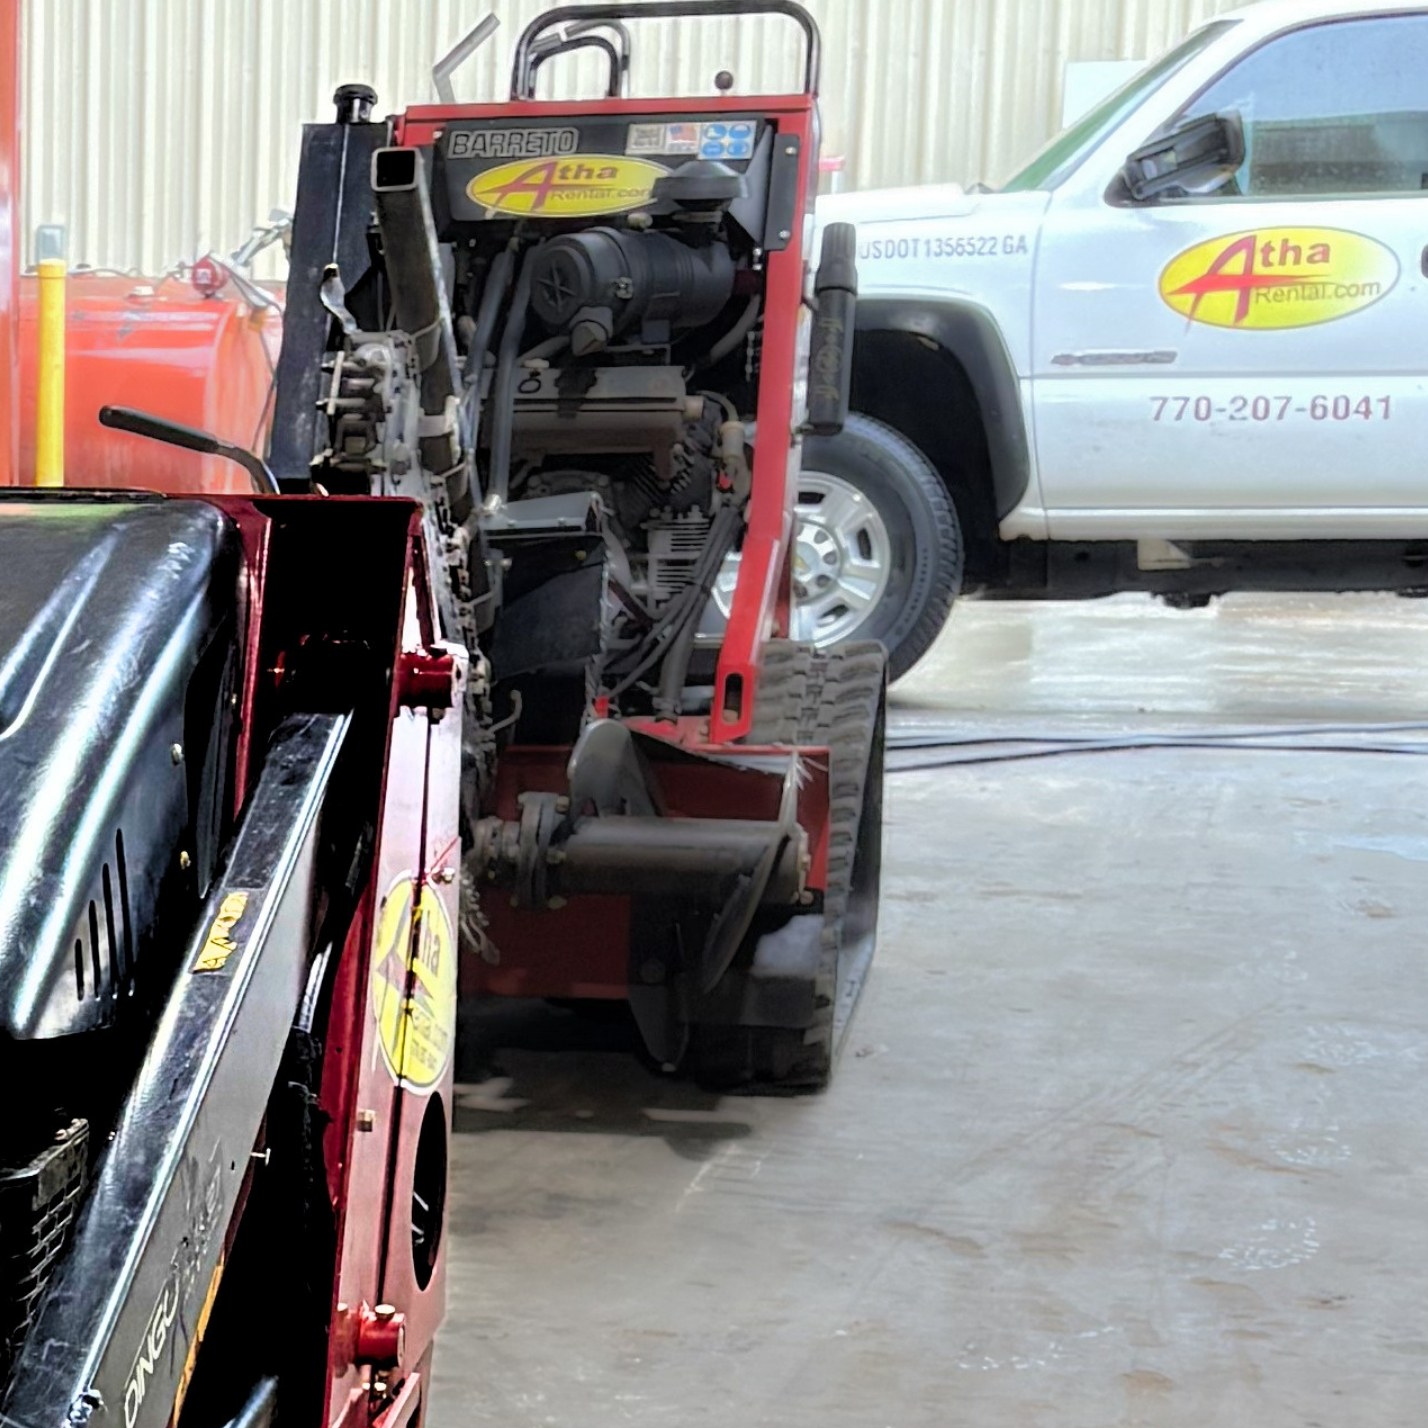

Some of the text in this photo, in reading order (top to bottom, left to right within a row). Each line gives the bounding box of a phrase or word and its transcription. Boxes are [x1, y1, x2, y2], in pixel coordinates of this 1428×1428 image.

[447, 127, 580, 159] BARRETO
[476, 160, 619, 213] Atha
[859, 238, 919, 260] USDOT
[1002, 235, 1028, 255] GA
[1165, 234, 1334, 330] Atha
[1255, 281, 1382, 304] Rental.com
[1149, 394, 1392, 422] 770-207-6041
